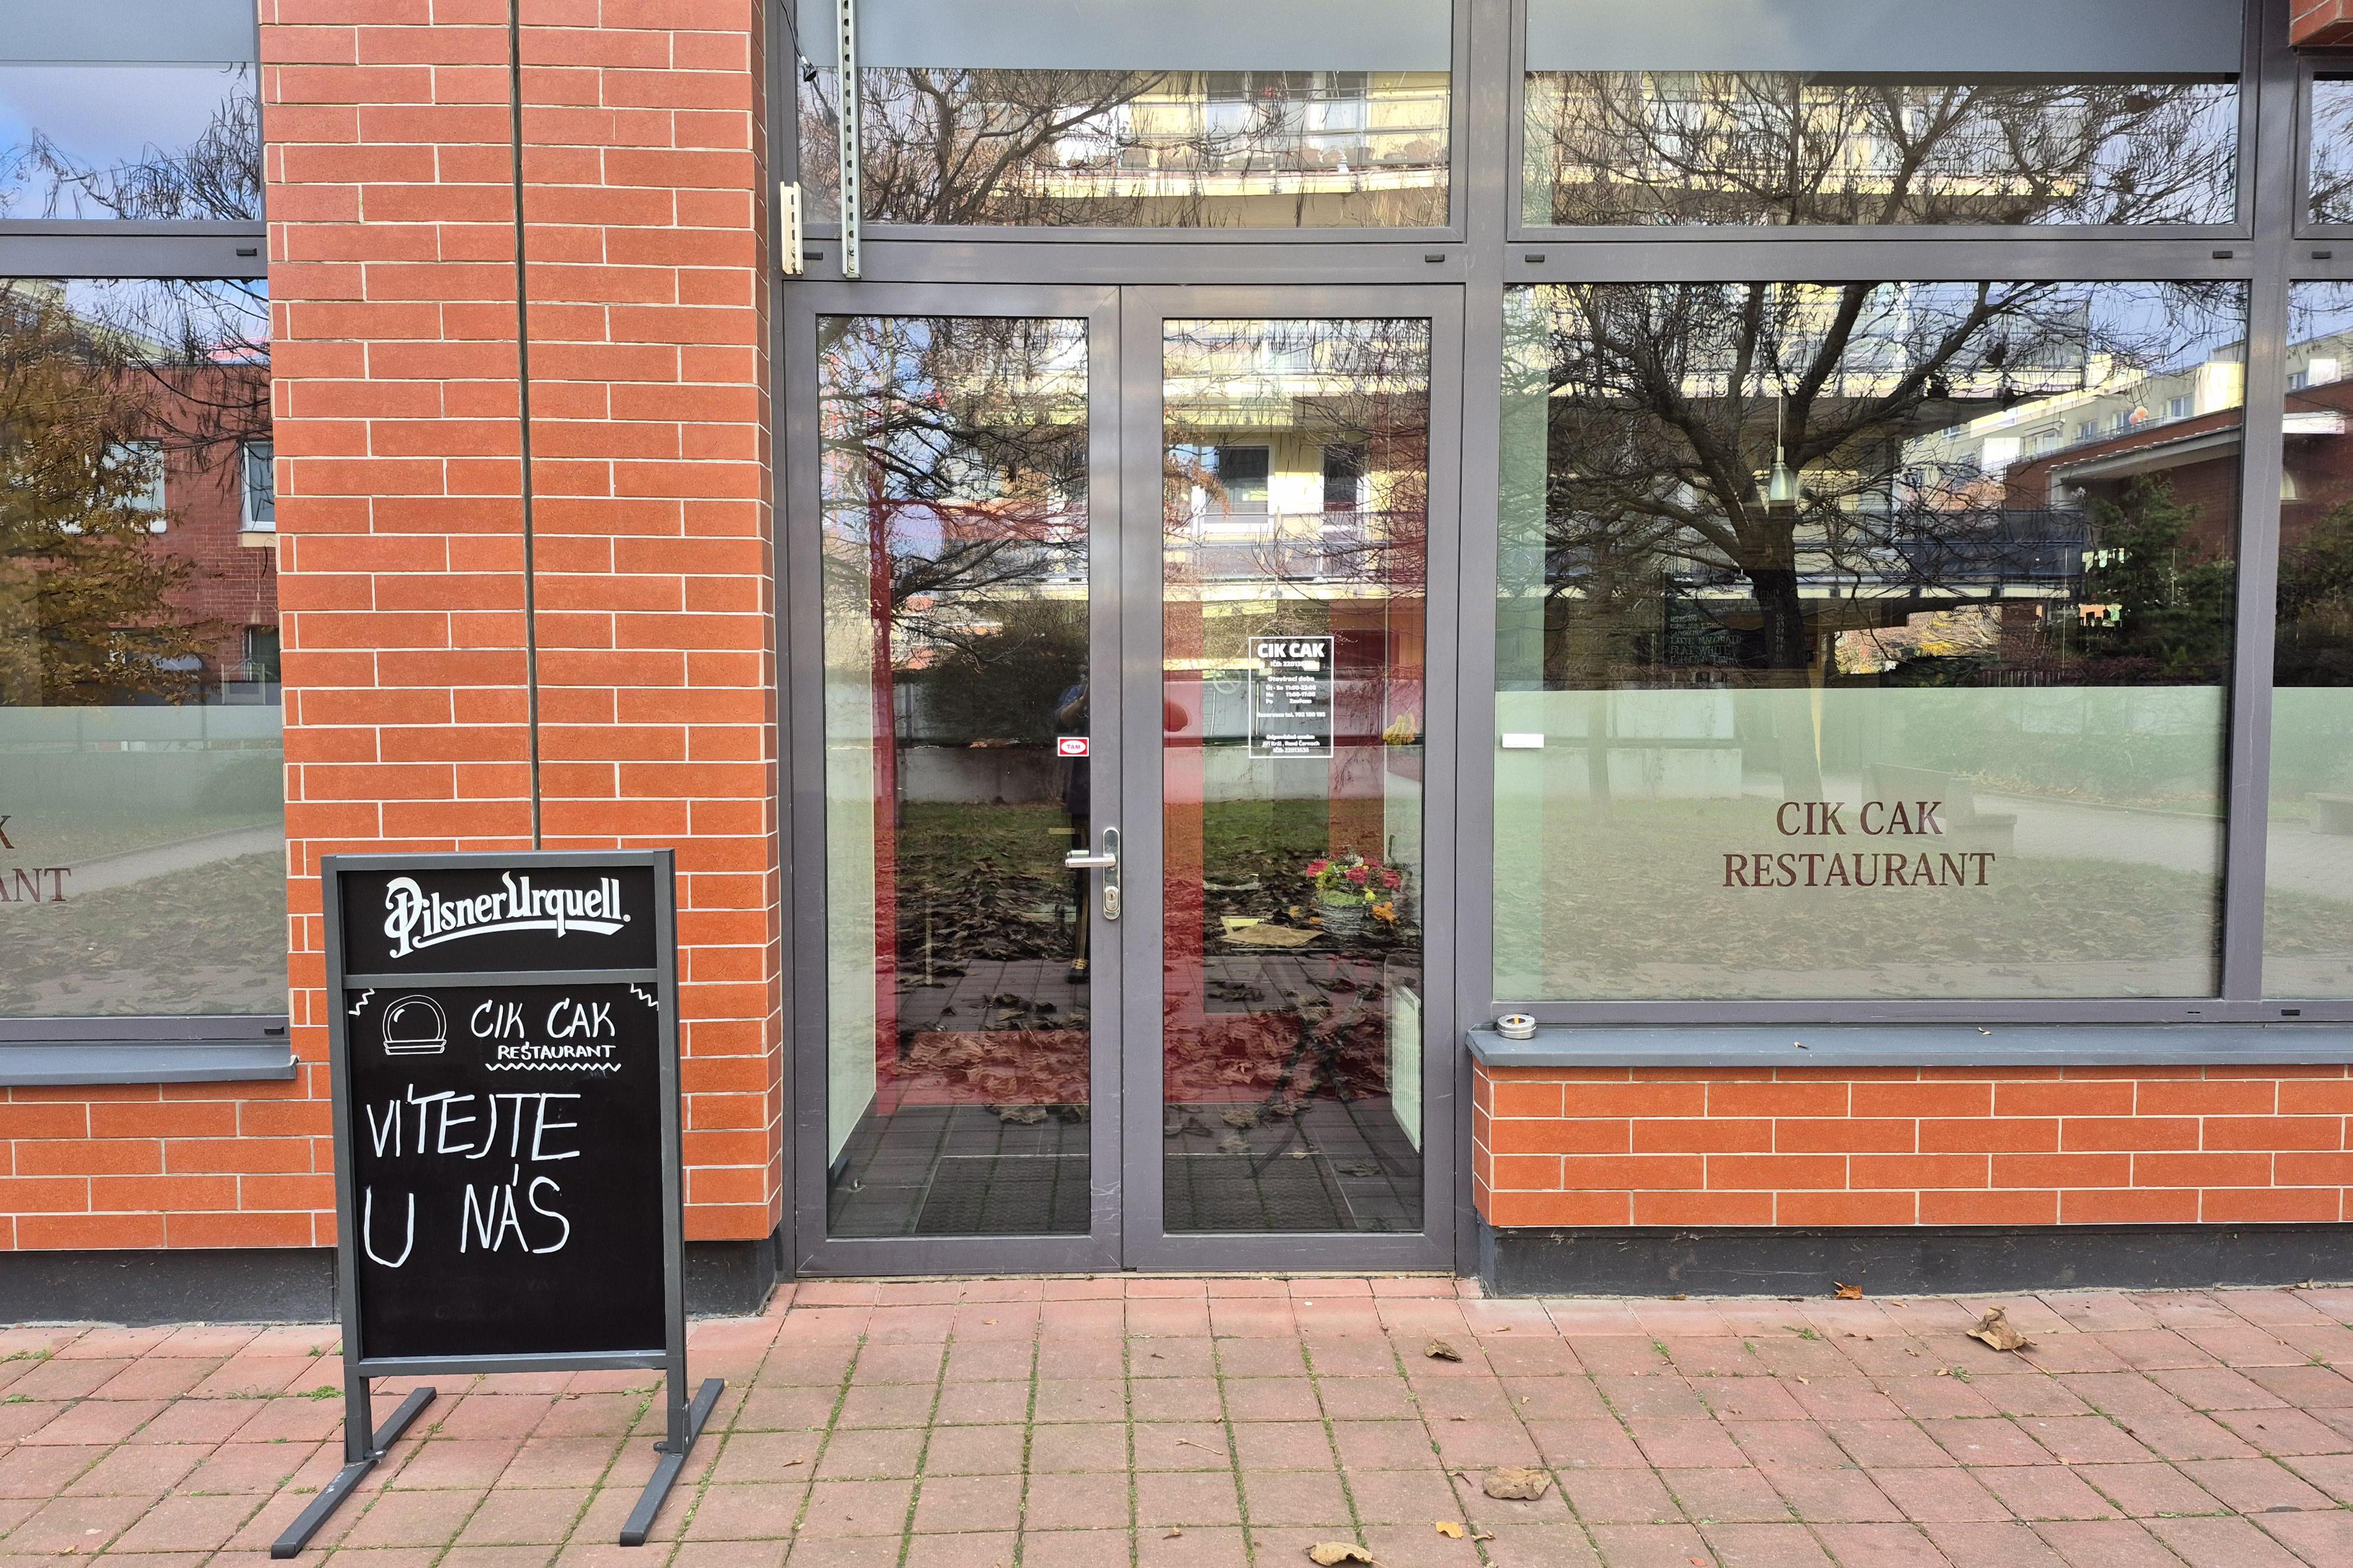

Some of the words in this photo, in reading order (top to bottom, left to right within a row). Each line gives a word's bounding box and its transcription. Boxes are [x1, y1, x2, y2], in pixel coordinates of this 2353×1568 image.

[1257, 643, 1287, 658] CIK
[1289, 643, 1325, 658] CAK
[1777, 802, 1847, 835] CIK
[1860, 802, 1943, 835] CAK
[1722, 853, 1995, 887] RESTAURANT
[384, 877, 508, 958] Pilsner
[502, 871, 622, 938] Urquell
[471, 999, 525, 1039] CIK
[546, 997, 615, 1038] CAK
[498, 1042, 616, 1060] RESTAURANT
[366, 1083, 581, 1161] VÍTEJTE
[364, 1186, 415, 1268] U
[460, 1163, 570, 1254] NÁS
